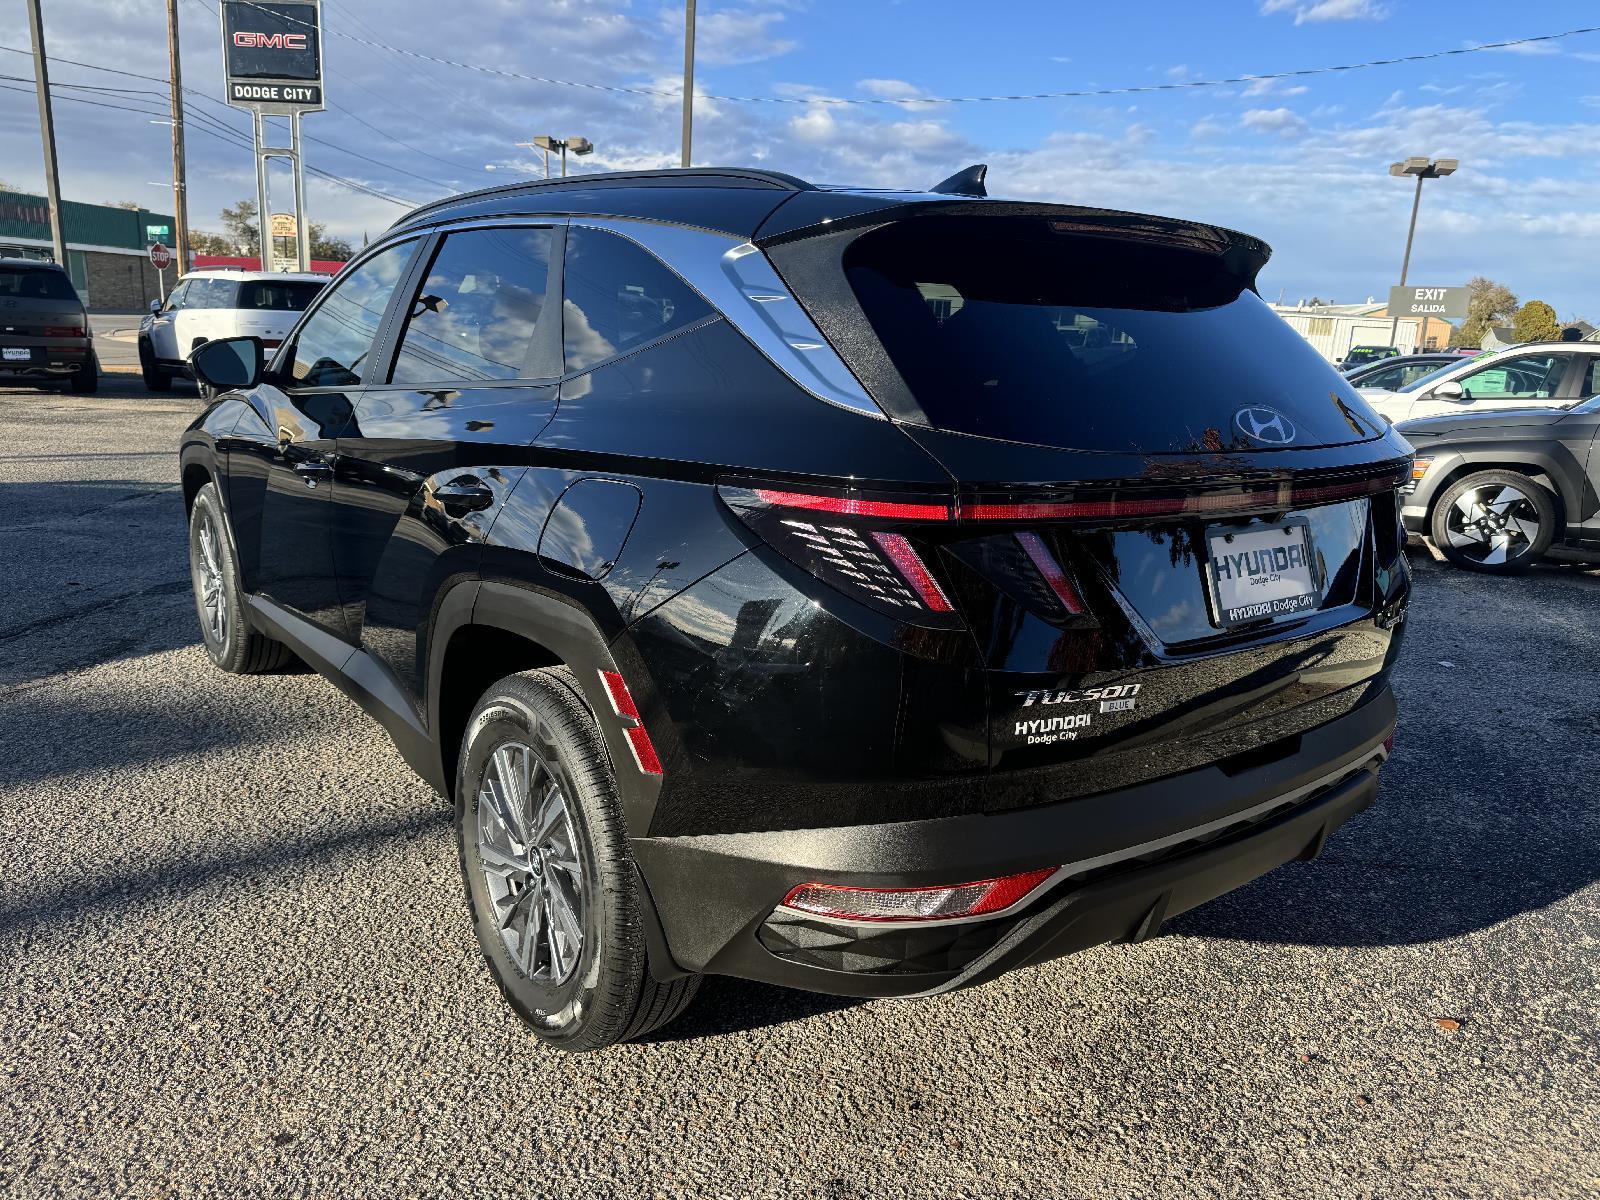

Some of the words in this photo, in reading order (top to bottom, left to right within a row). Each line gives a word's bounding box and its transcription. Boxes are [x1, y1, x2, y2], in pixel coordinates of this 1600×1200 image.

[233, 32, 306, 49] GMC
[235, 86, 278, 99] DODGE
[283, 88, 312, 100] CITY
[152, 251, 169, 262] STOP
[1414, 288, 1446, 300] EXIT
[1410, 304, 1446, 313] SALIDA
[1214, 543, 1307, 582] HYUNDAI
[1250, 575, 1269, 587] Dodge
[1269, 573, 1281, 583] City
[1229, 601, 1271, 621] HYUNDAI
[1272, 598, 1298, 612] Dodge
[1298, 594, 1314, 607] City
[1108, 700, 1129, 711] BLUE
[1014, 713, 1091, 735] HYUNDAI
[1027, 733, 1058, 744] Dodge
[1059, 730, 1077, 740] City
